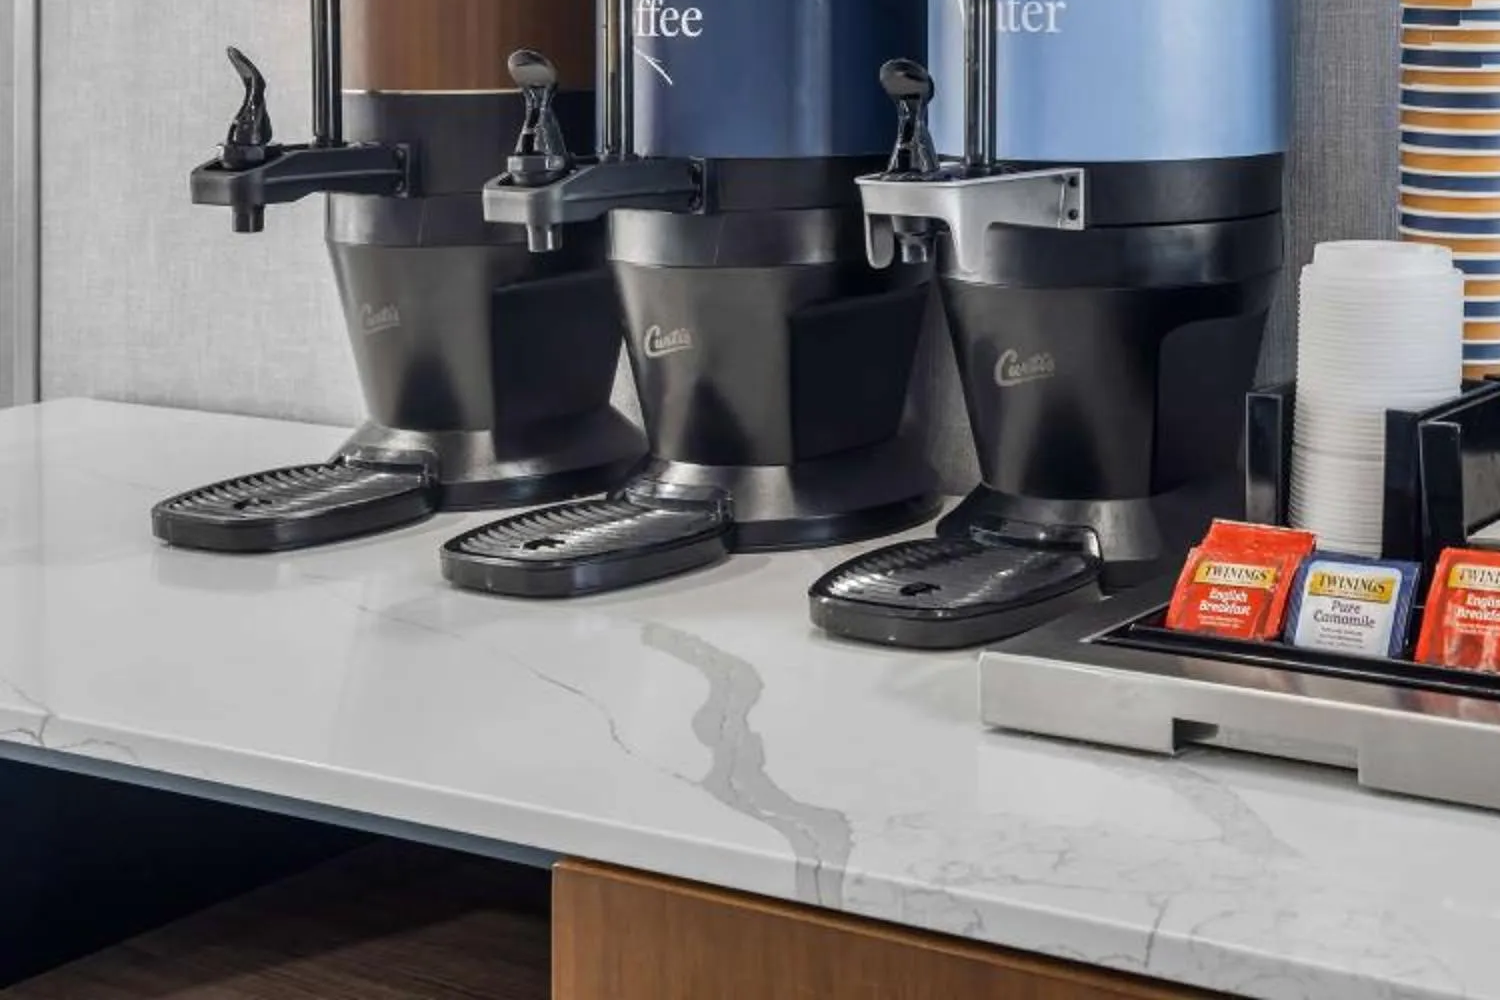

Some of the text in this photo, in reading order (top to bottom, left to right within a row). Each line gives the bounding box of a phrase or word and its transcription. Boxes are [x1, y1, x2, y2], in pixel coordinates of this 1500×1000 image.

[1204, 563, 1268, 582] TWININGS
[1319, 574, 1385, 593] TWININGS
[1209, 587, 1249, 605] English
[1199, 601, 1251, 615] Breakfast
[1331, 600, 1361, 614] Pure
[1313, 610, 1376, 628] Camomile
